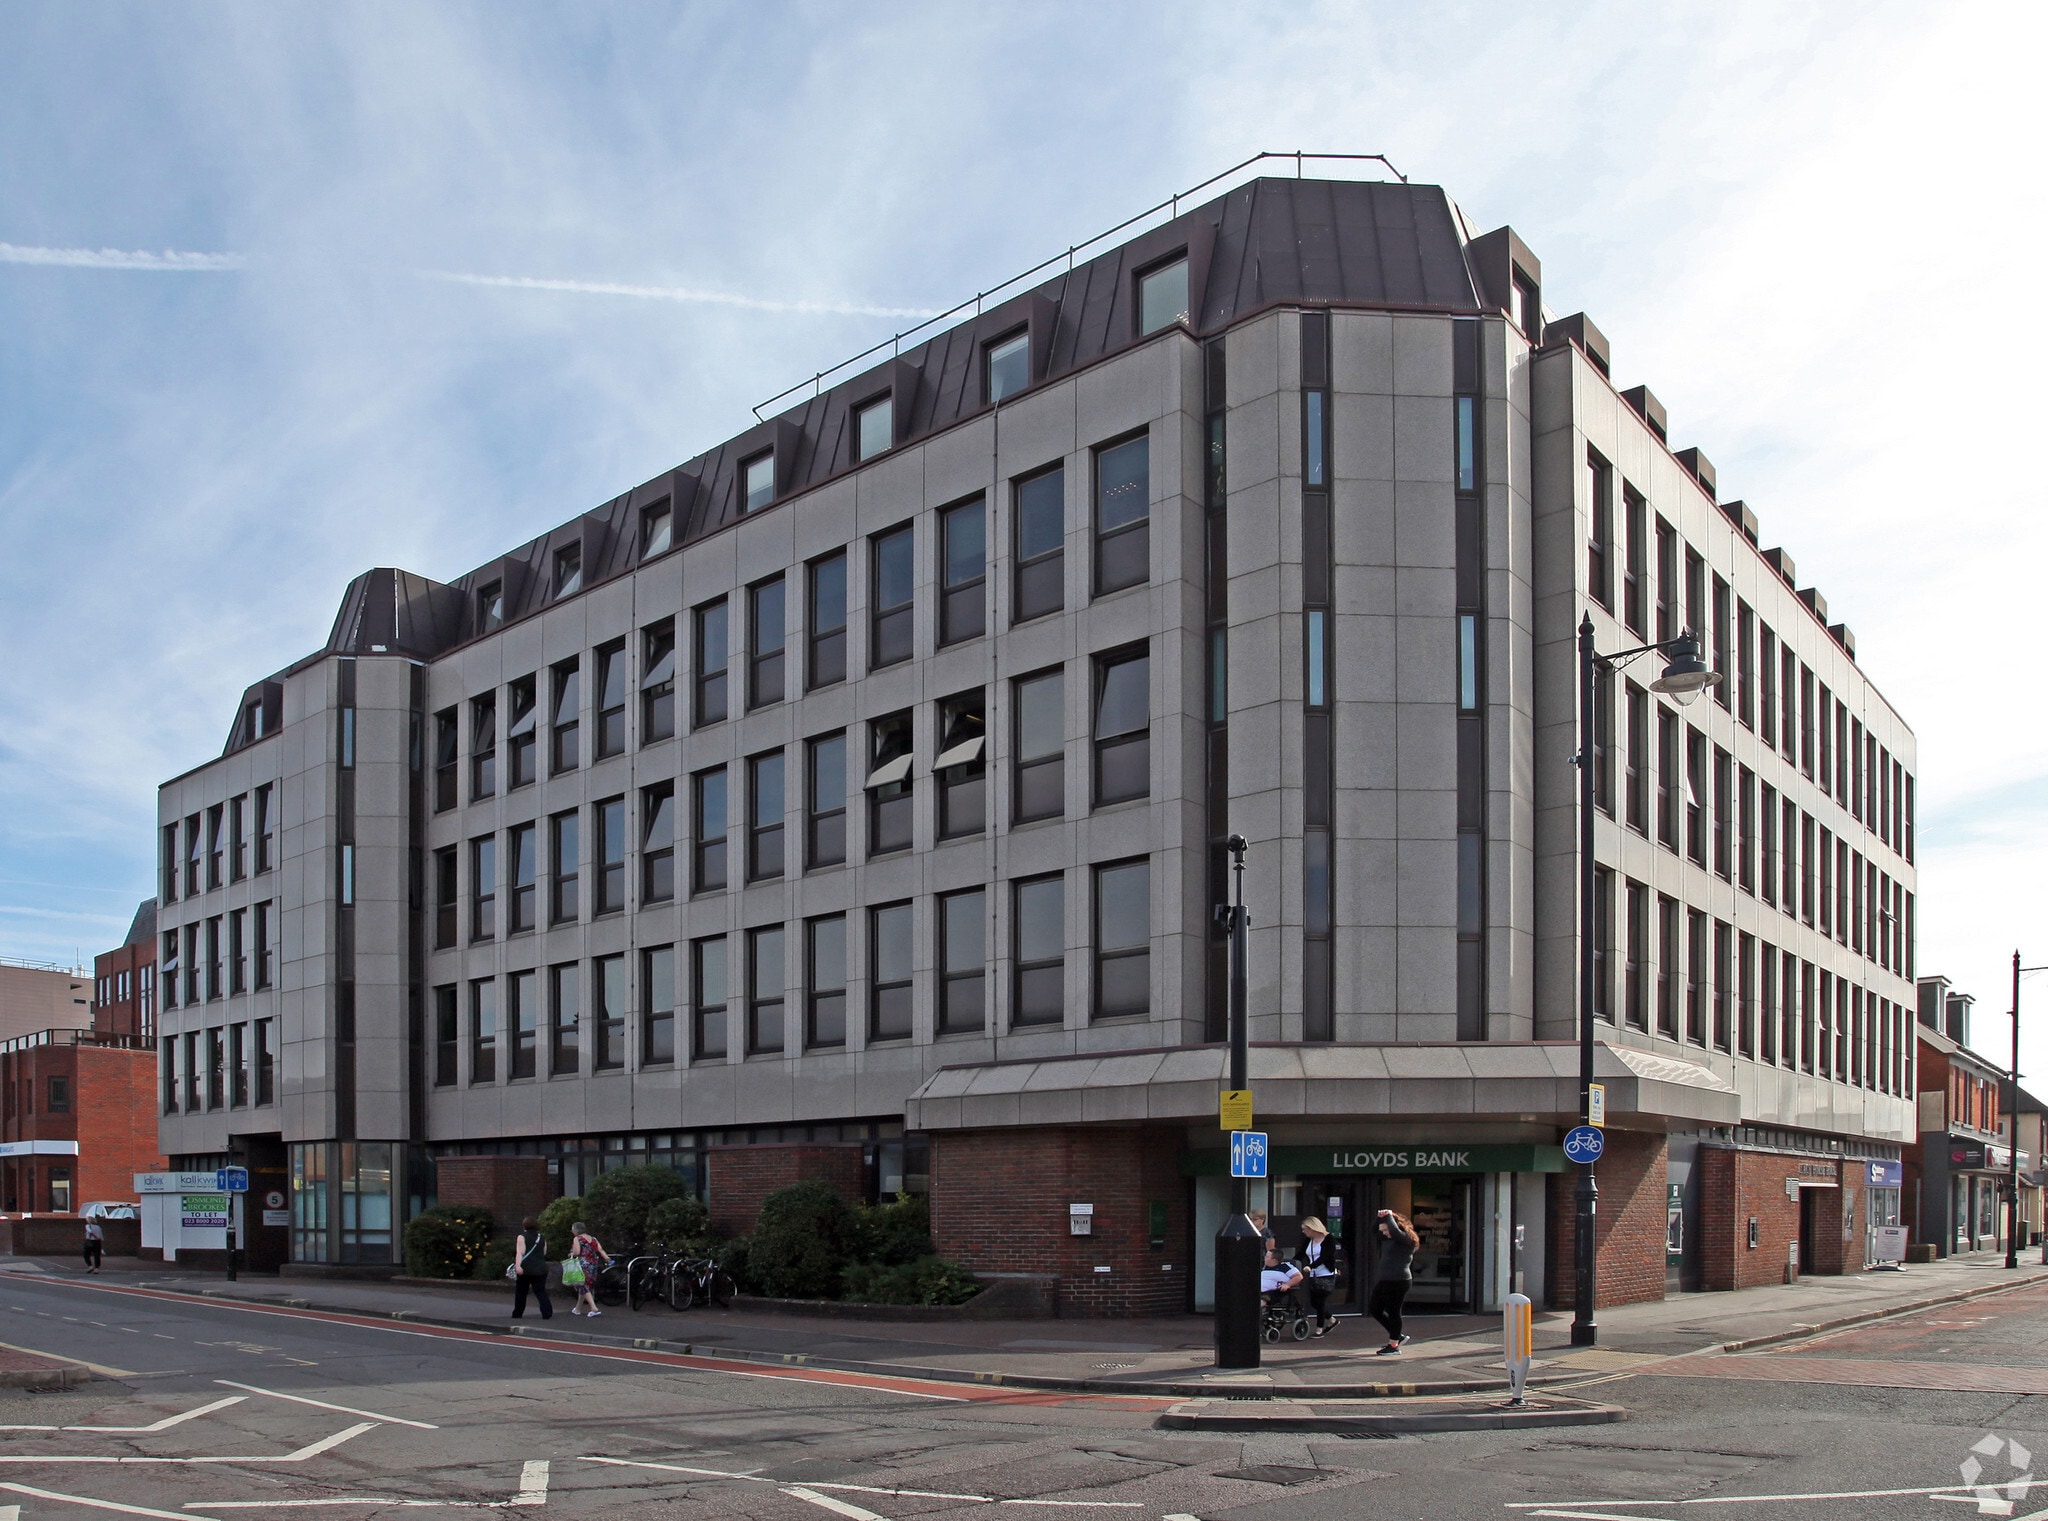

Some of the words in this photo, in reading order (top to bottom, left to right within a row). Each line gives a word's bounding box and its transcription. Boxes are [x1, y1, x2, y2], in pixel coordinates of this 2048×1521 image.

[1333, 1153, 1408, 1168] LLOYDS
[1415, 1152, 1470, 1167] BANK
[271, 1195, 279, 1205] 5
